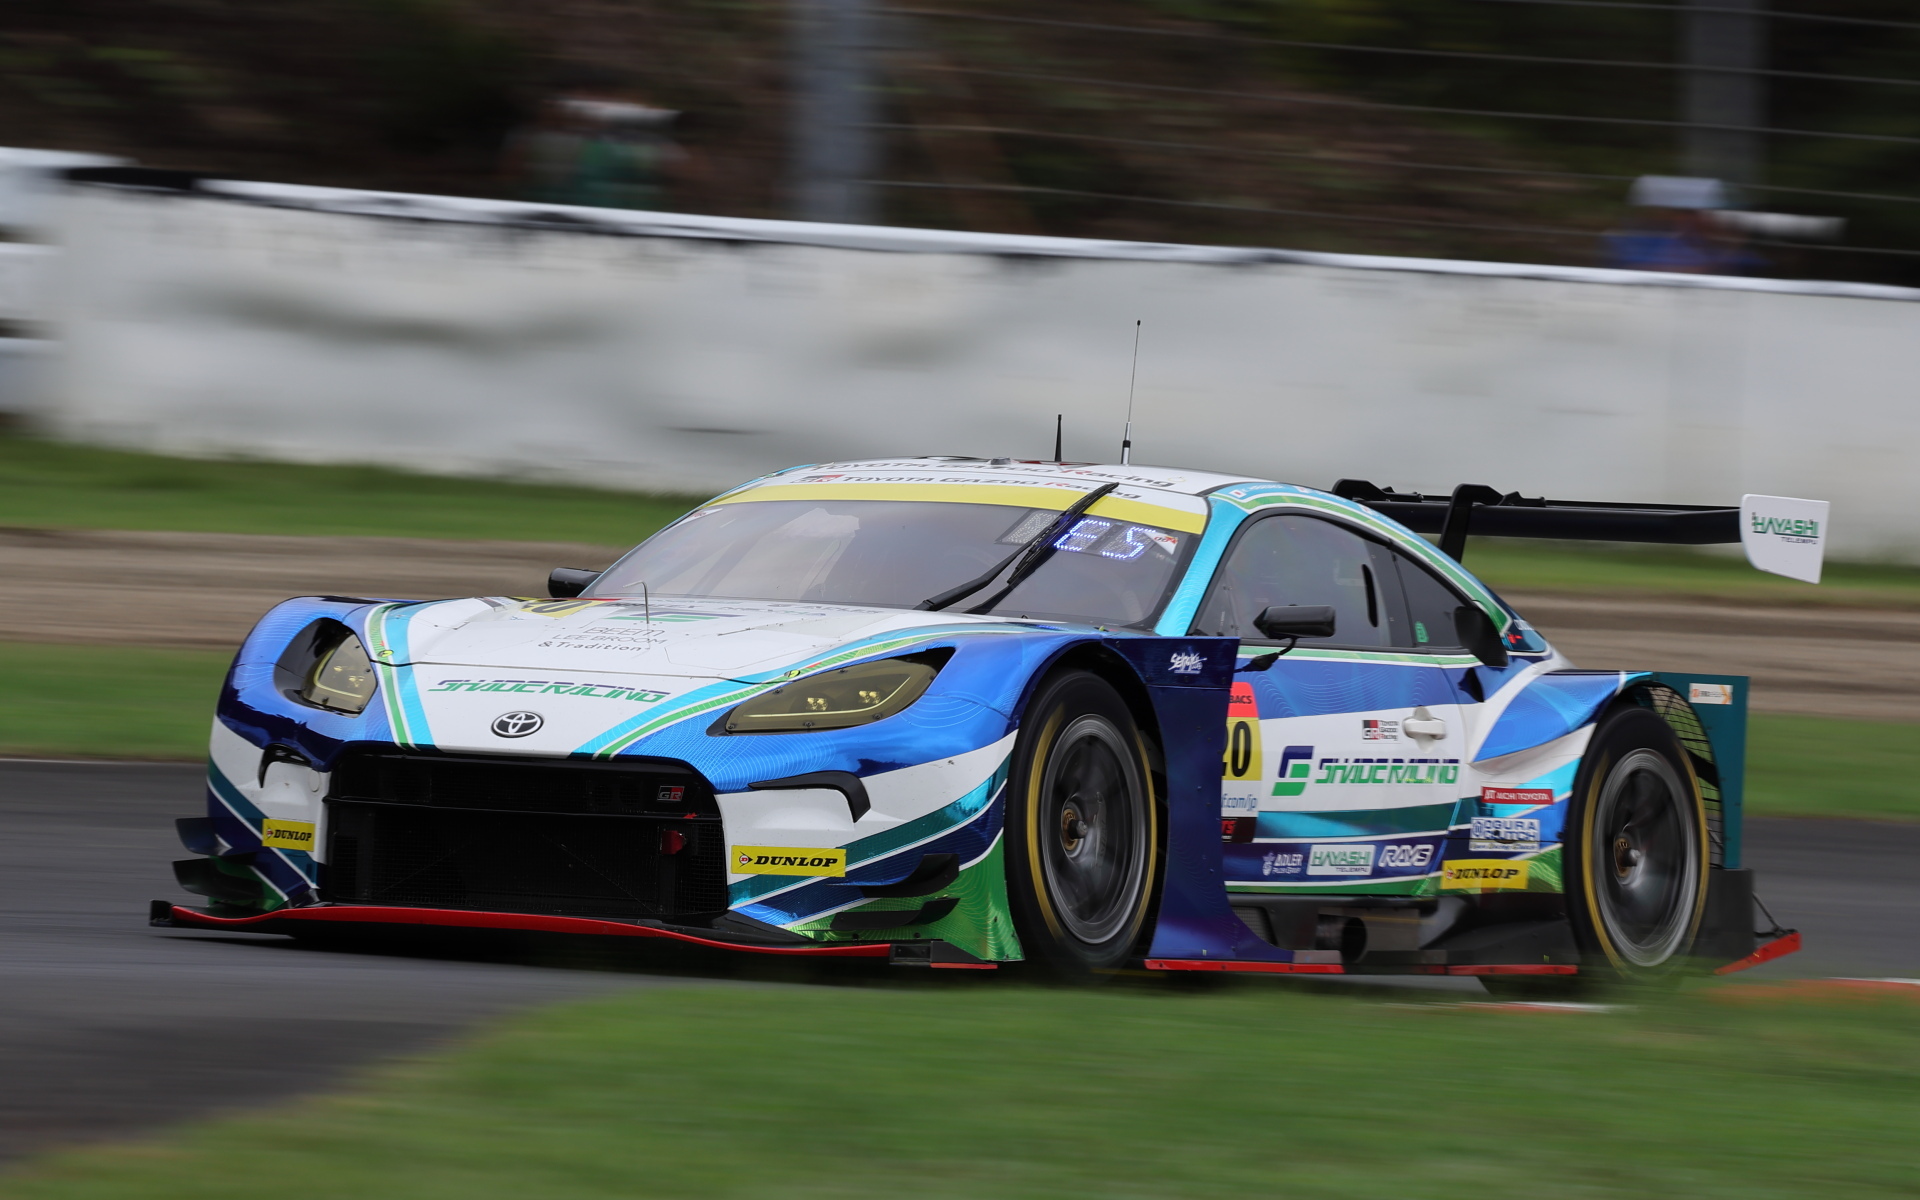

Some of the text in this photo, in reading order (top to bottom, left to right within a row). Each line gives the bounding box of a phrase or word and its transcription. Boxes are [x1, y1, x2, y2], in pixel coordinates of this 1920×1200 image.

[1063, 469, 1175, 487] Racing
[939, 477, 1039, 485] GAZOO
[1043, 481, 1142, 499] Racng
[658, 791, 683, 800] GR
[1484, 819, 1536, 830] OGURA
[273, 829, 312, 842] DUNLOP
[754, 855, 838, 868] DUNLOP
[1311, 850, 1371, 866] HAYASHI
[1377, 845, 1435, 868] RAYS
[1453, 868, 1519, 880] DUNLOP
